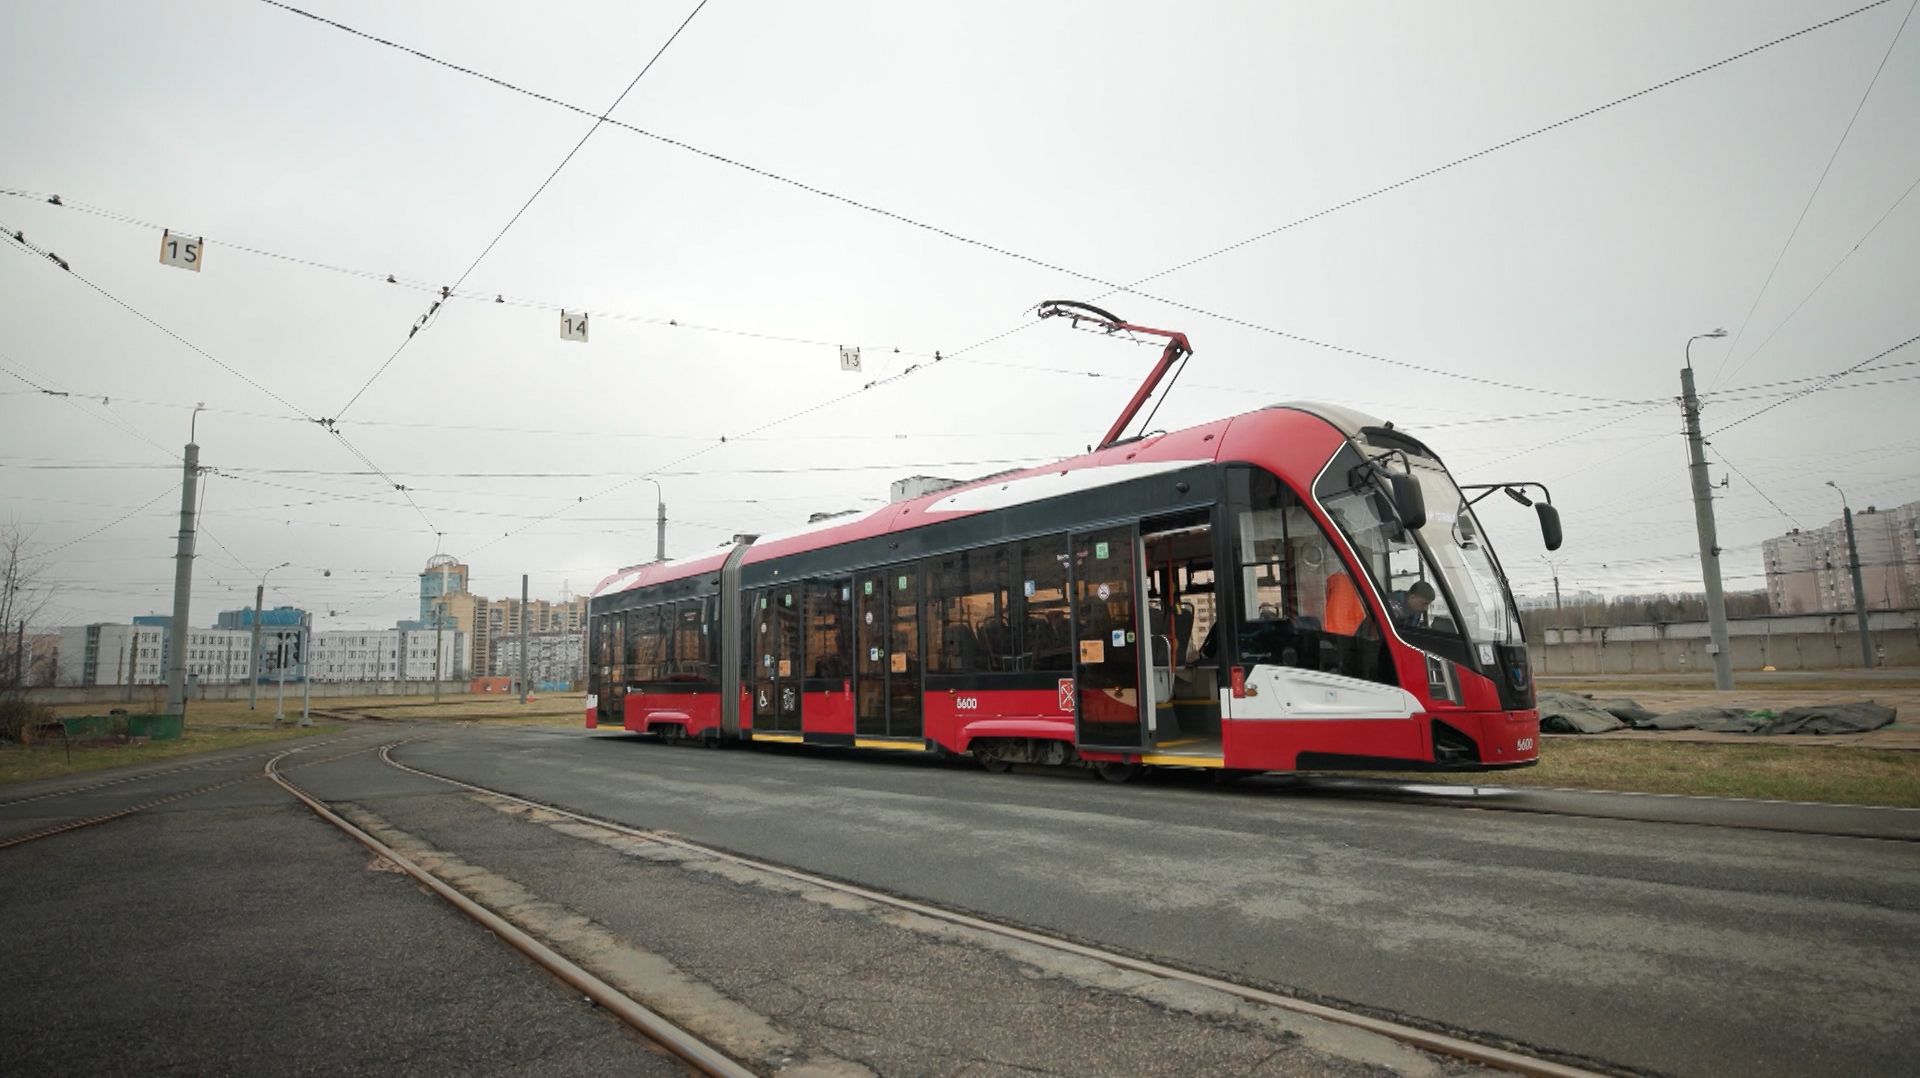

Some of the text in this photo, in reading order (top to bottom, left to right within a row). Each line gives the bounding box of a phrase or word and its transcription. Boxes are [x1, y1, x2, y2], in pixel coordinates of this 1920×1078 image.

[167, 240, 197, 263] 15
[564, 318, 585, 337] 14
[843, 352, 860, 367] 13
[956, 697, 977, 709] 5600
[1516, 738, 1533, 751] 5600
